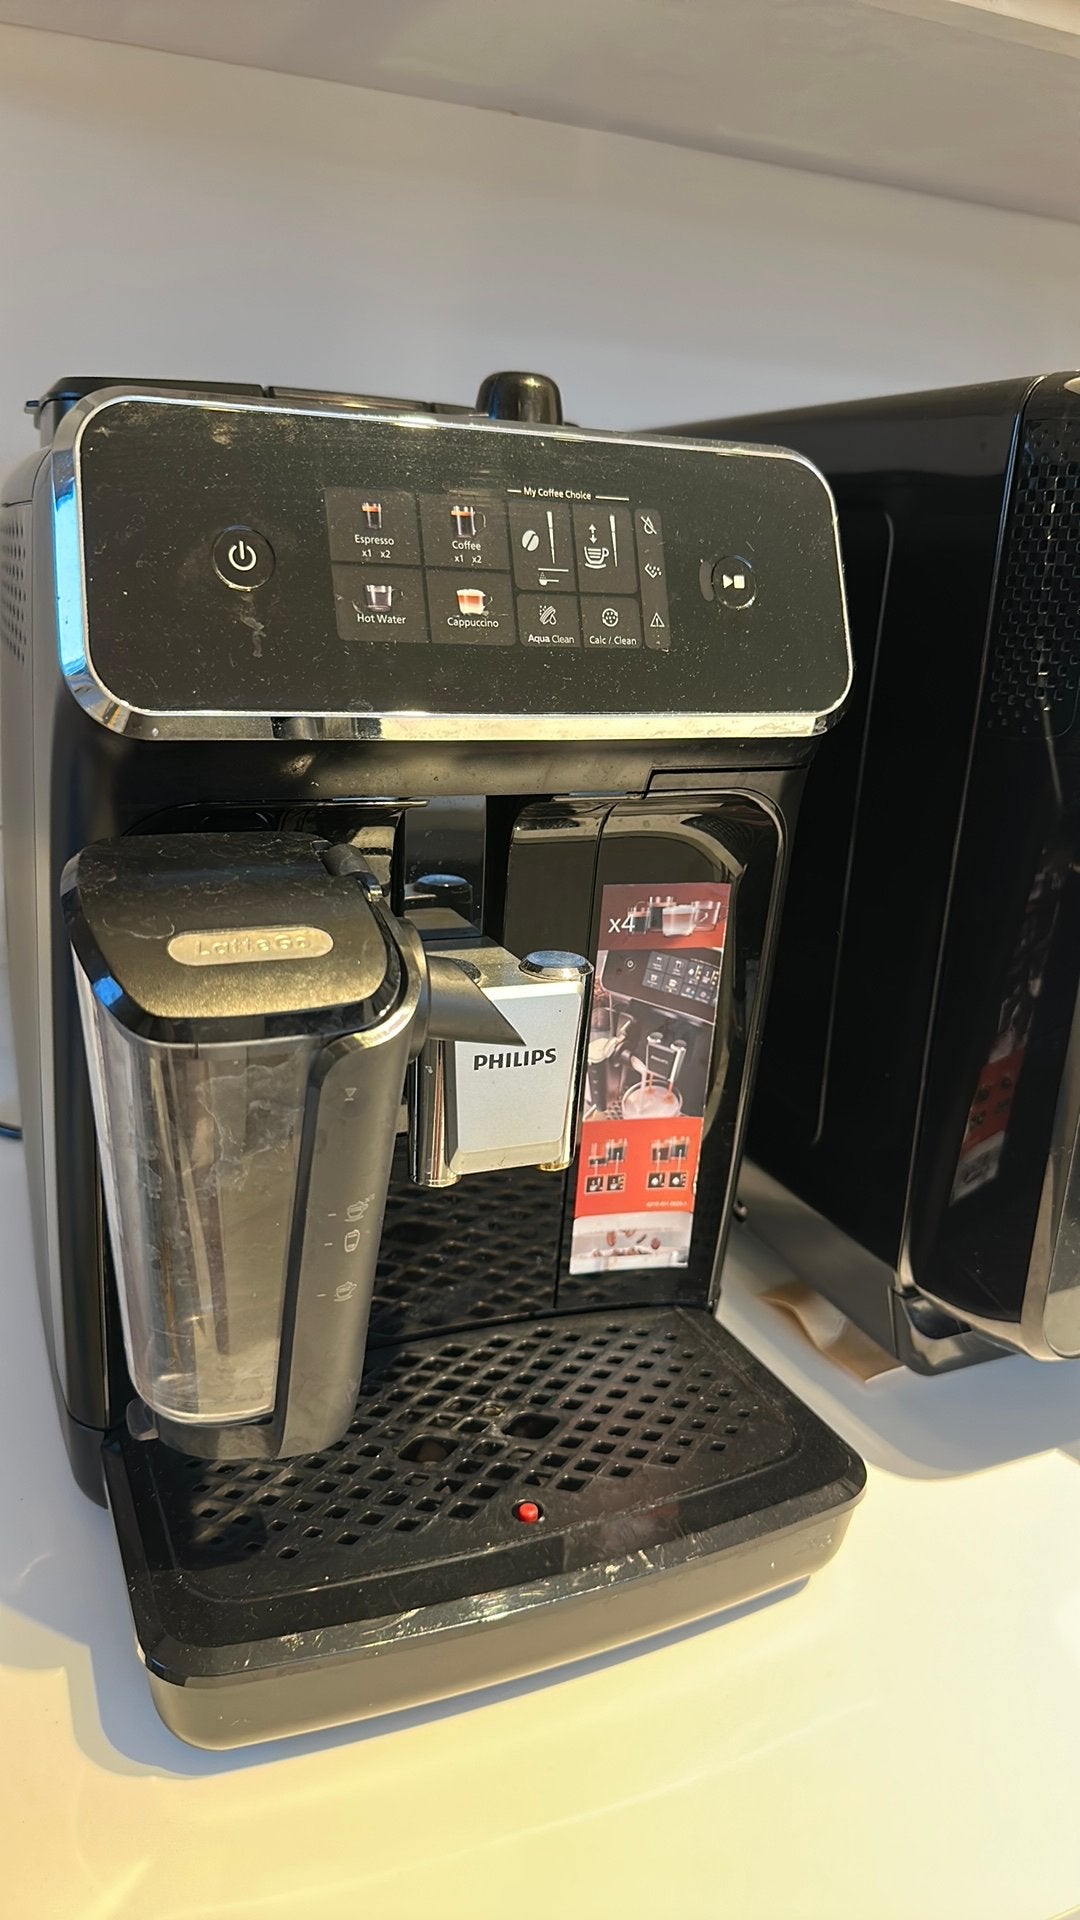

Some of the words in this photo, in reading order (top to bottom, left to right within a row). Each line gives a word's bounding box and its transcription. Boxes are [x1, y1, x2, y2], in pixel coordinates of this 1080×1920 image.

[523, 486, 537, 498] My
[537, 487, 564, 498] Coffee
[565, 490, 592, 500] Choice
[354, 534, 395, 546] Espresso
[451, 540, 482, 551] Coffee
[361, 549, 372, 557] x1
[380, 549, 391, 558] x2
[454, 554, 464, 563] x1
[471, 555, 482, 564] x2
[356, 613, 375, 623] Hot
[377, 614, 406, 625] Water
[447, 617, 499, 629] Cappuccino
[528, 634, 550, 644] Aqua
[551, 634, 575, 644] Clean
[589, 635, 606, 645] Calc
[614, 636, 637, 646] Clean
[608, 913, 635, 933] x4
[195, 934, 310, 956] LatteGo
[473, 1048, 557, 1071] PHILIPS
